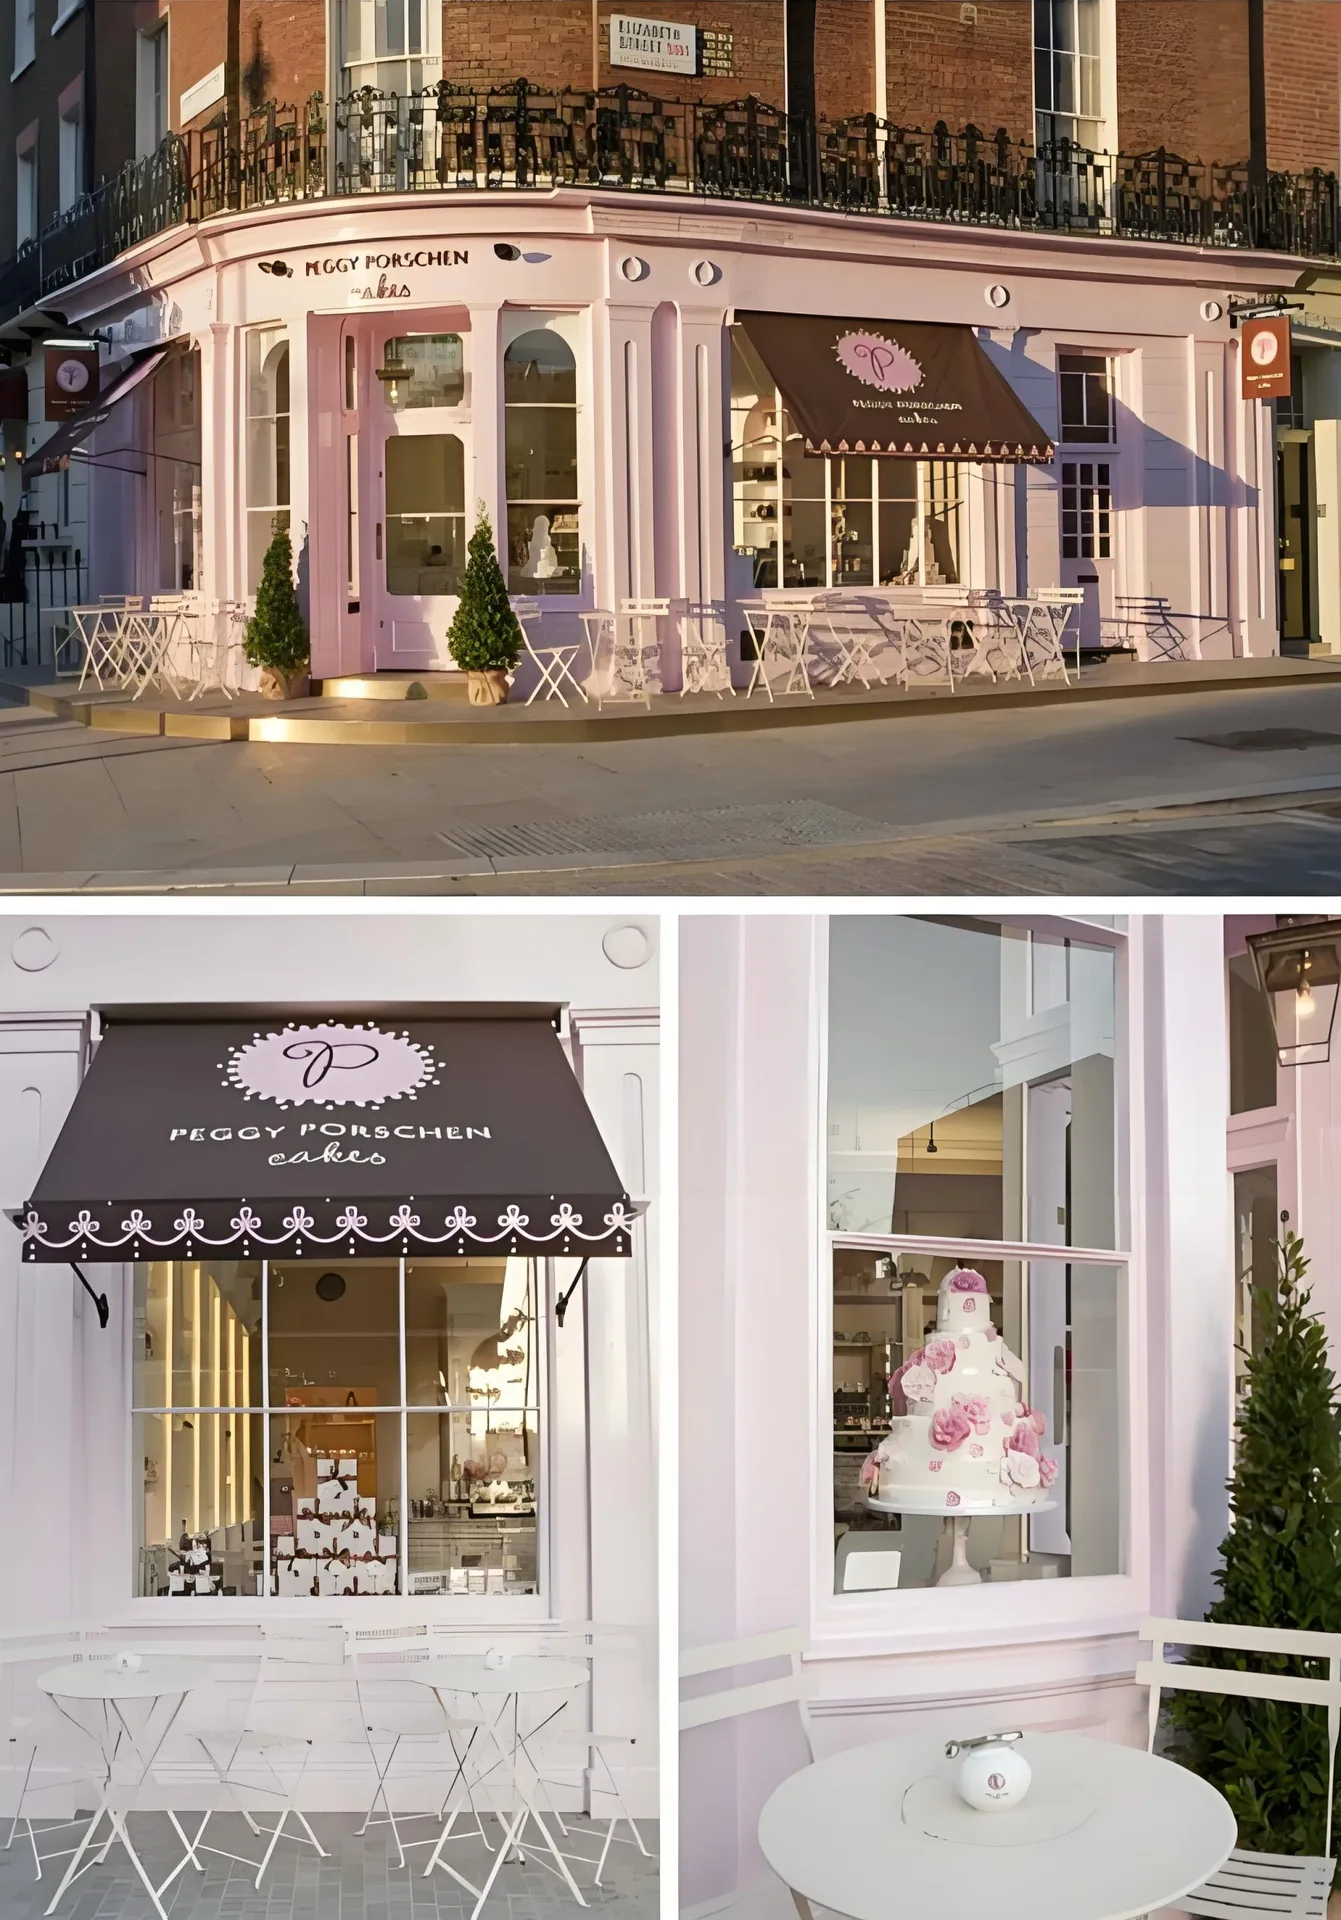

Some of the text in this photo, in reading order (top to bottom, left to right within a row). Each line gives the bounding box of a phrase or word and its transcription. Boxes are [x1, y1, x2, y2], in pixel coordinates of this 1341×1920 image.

[365, 250, 469, 269] PORSCHEN
[169, 1122, 492, 1141] PEGGY PORSCHEN
[268, 1141, 386, 1166] cakes
